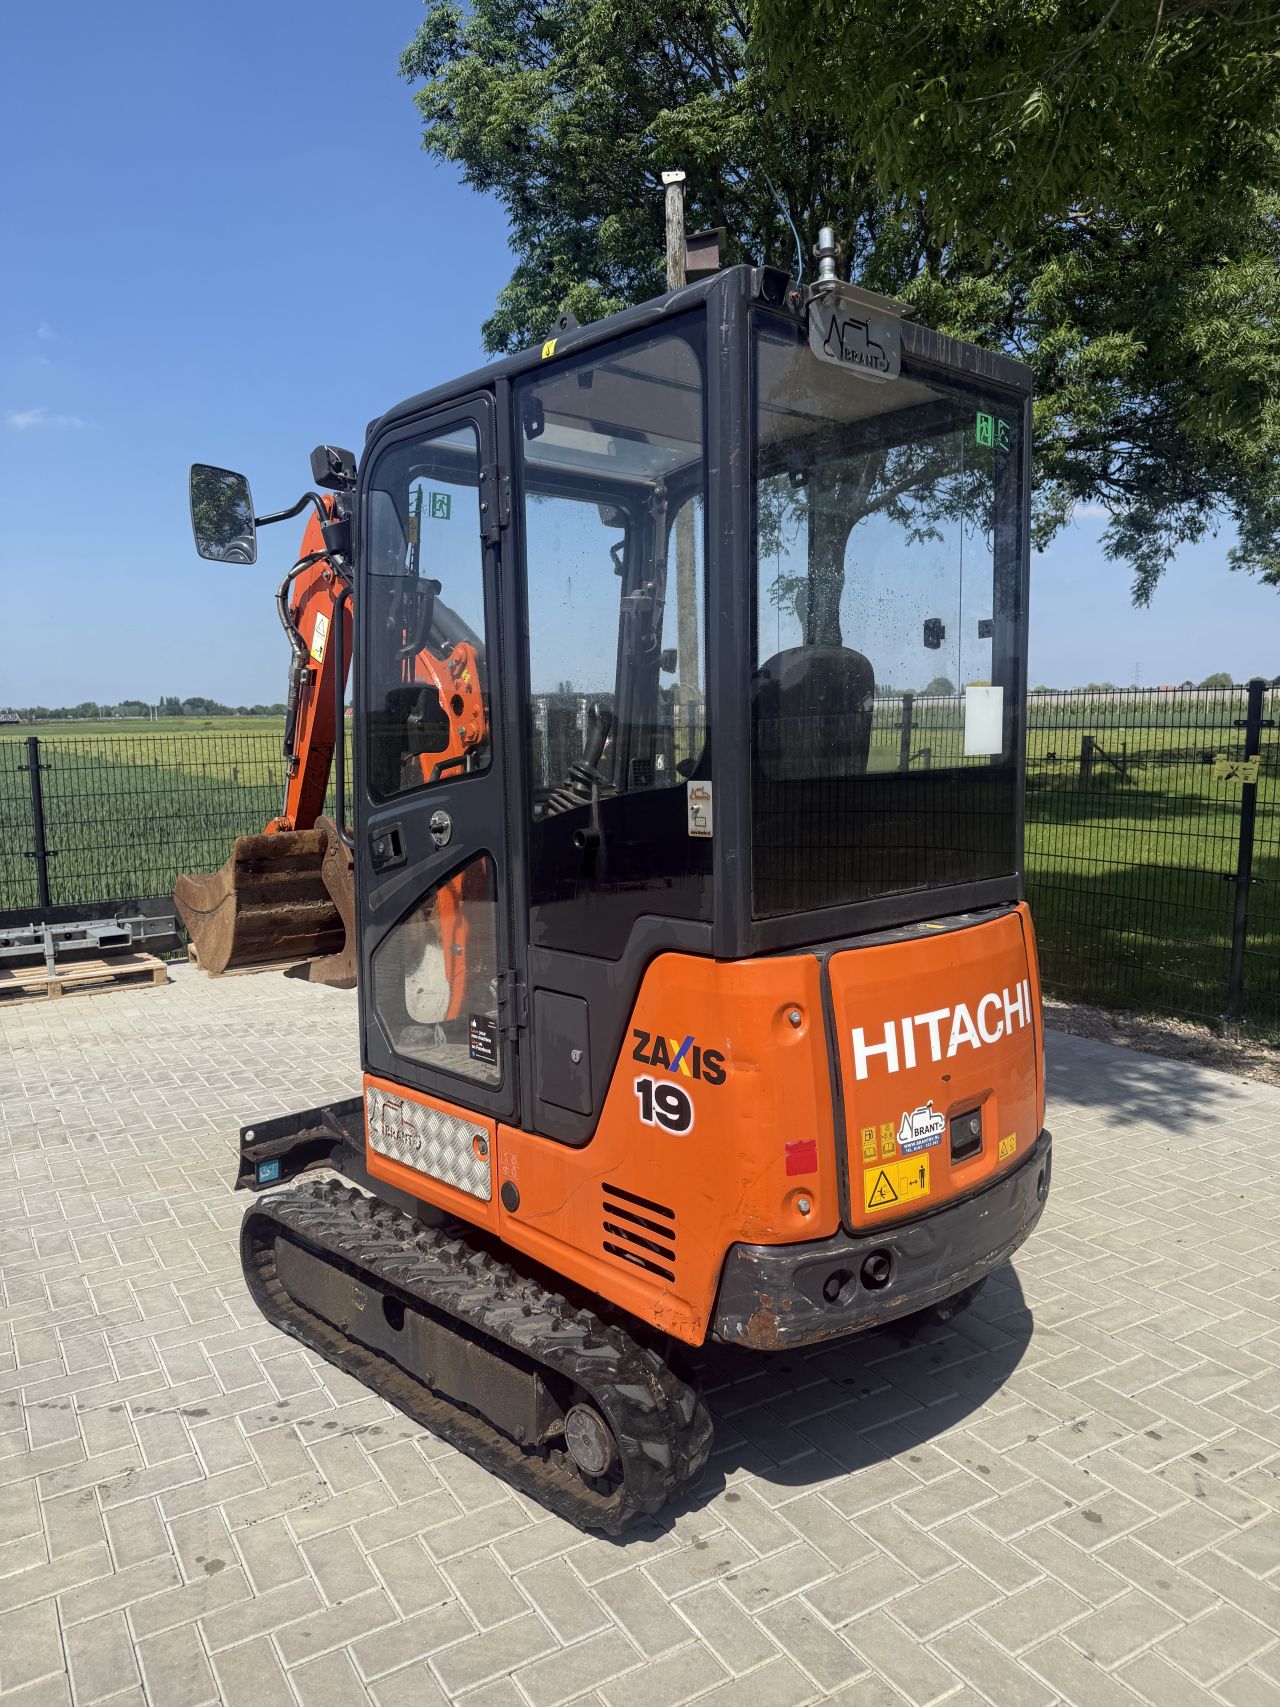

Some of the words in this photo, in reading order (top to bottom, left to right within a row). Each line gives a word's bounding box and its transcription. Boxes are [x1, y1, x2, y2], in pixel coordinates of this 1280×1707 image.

[844, 348, 880, 369] BRANT
[632, 1028, 727, 1085] ZAXIS
[852, 979, 1031, 1080] HITACHI
[635, 1078, 692, 1132] 19
[914, 1122, 939, 1137] BRANT
